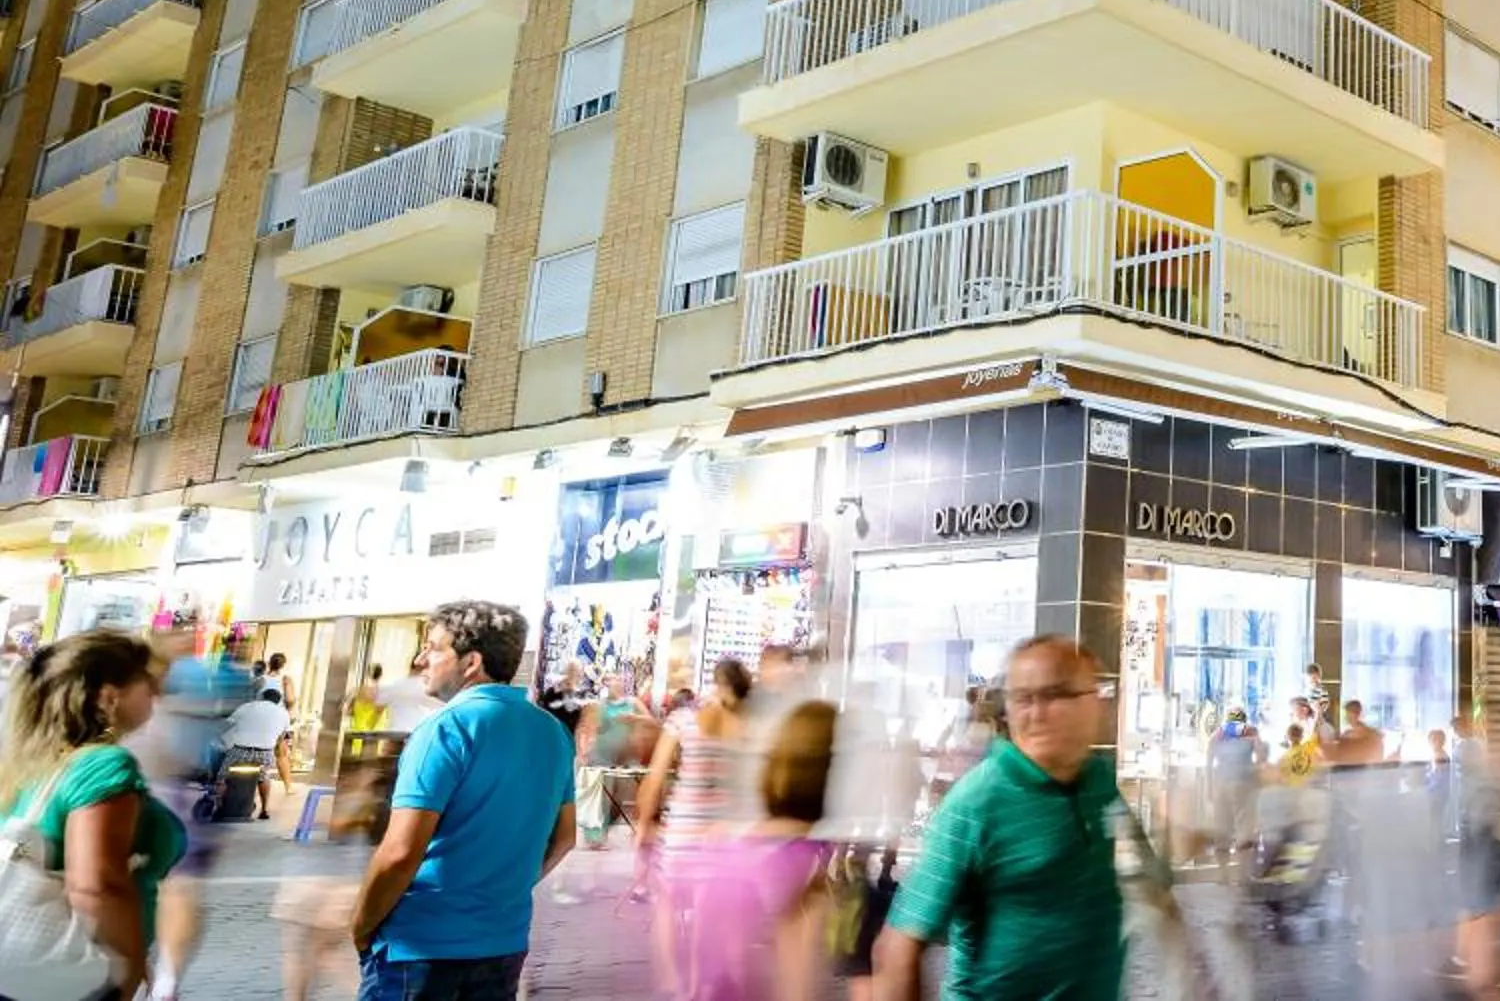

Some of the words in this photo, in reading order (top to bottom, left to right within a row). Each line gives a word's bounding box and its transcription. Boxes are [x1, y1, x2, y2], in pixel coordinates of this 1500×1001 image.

[253, 502, 415, 571] JOYCA
[932, 505, 949, 535] DI
[954, 498, 1030, 533] MARCO
[1136, 501, 1157, 532] DI
[1163, 503, 1236, 541] MARCO
